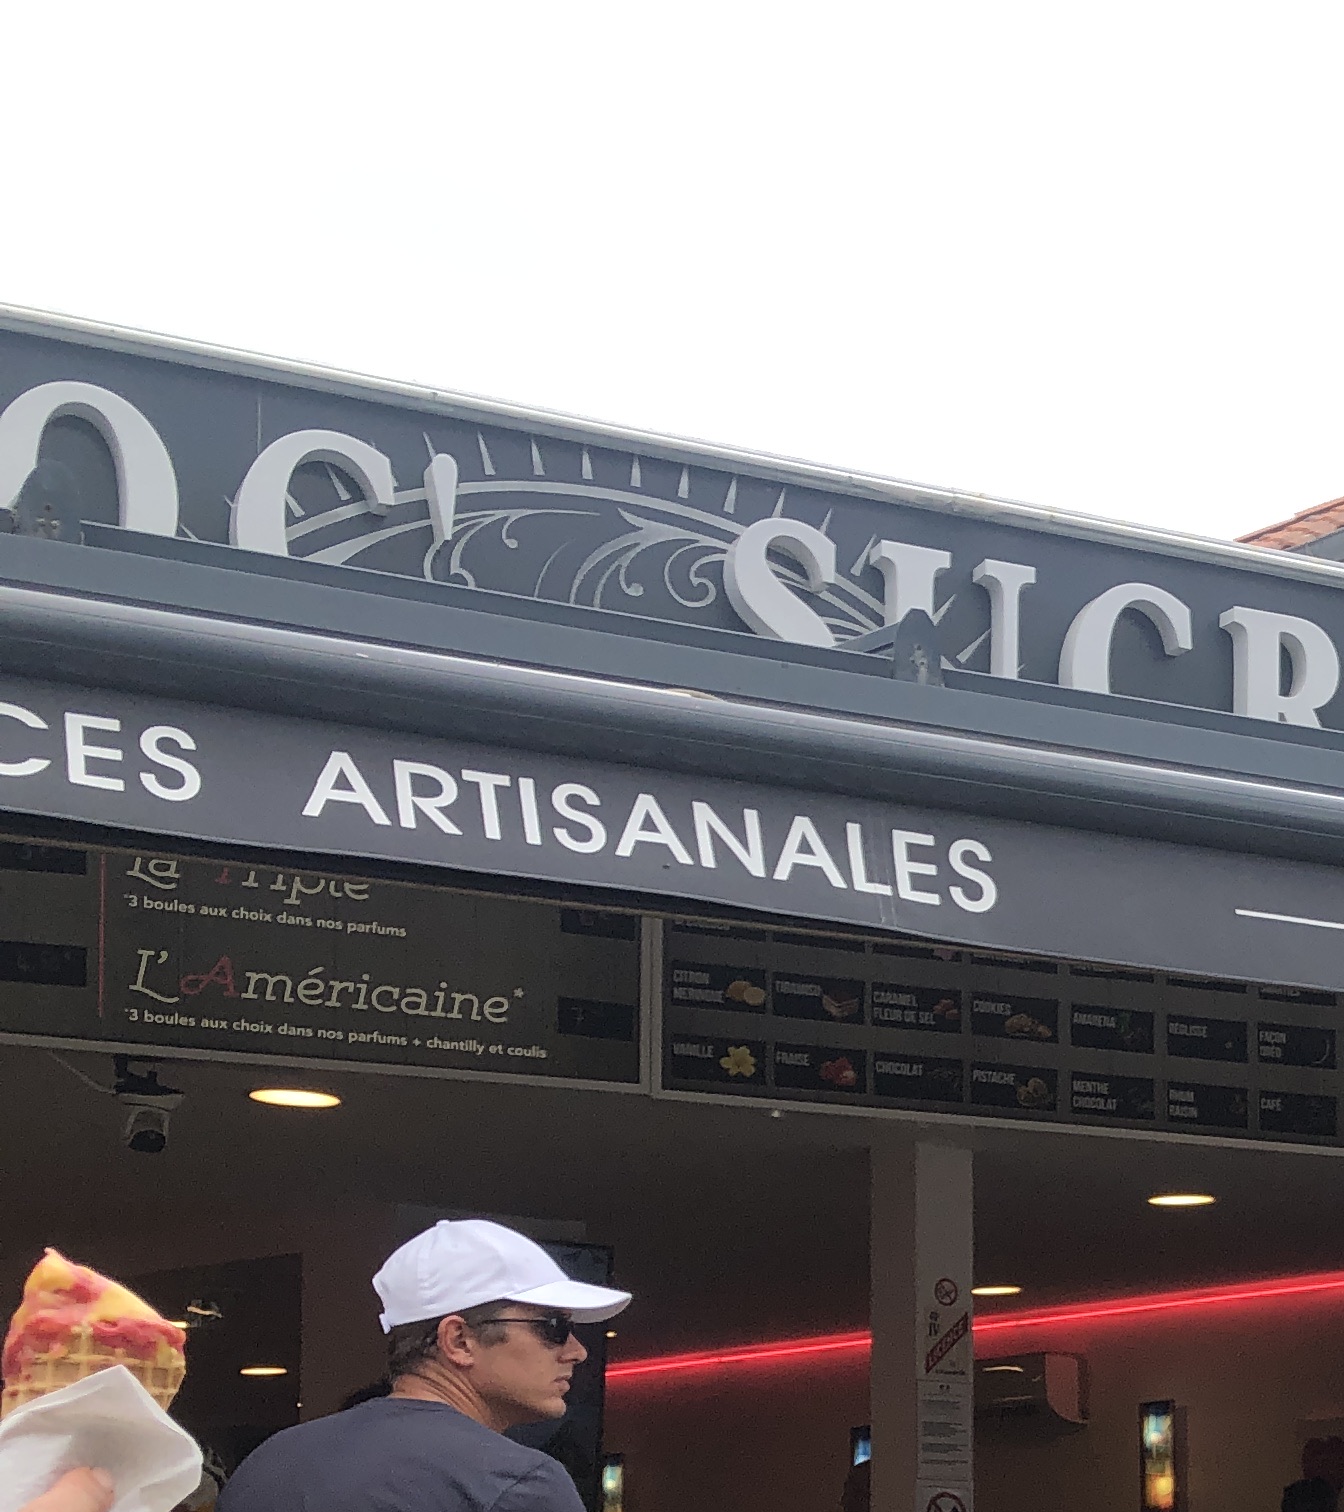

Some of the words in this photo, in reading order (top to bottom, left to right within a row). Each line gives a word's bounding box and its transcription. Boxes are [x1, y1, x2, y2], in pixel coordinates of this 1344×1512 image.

[302, 751, 997, 914] ARTISANALES
[143, 896, 196, 916] boules
[200, 905, 228, 918] aux
[232, 905, 273, 923] choix
[276, 911, 313, 928] dans
[317, 917, 343, 931] nos
[346, 917, 407, 939] parfums
[143, 1009, 197, 1028] boules
[200, 1018, 229, 1031] aux
[232, 1018, 273, 1035] choix
[277, 1022, 313, 1039] dans
[317, 1028, 344, 1042] nos
[348, 1030, 408, 1049] parfums
[426, 1035, 485, 1056] chantilly
[488, 1041, 504, 1054] et
[507, 1043, 548, 1060] coulis
[875, 1060, 924, 1077] CHOCOLAT
[972, 1069, 1016, 1086] PISTACHE
